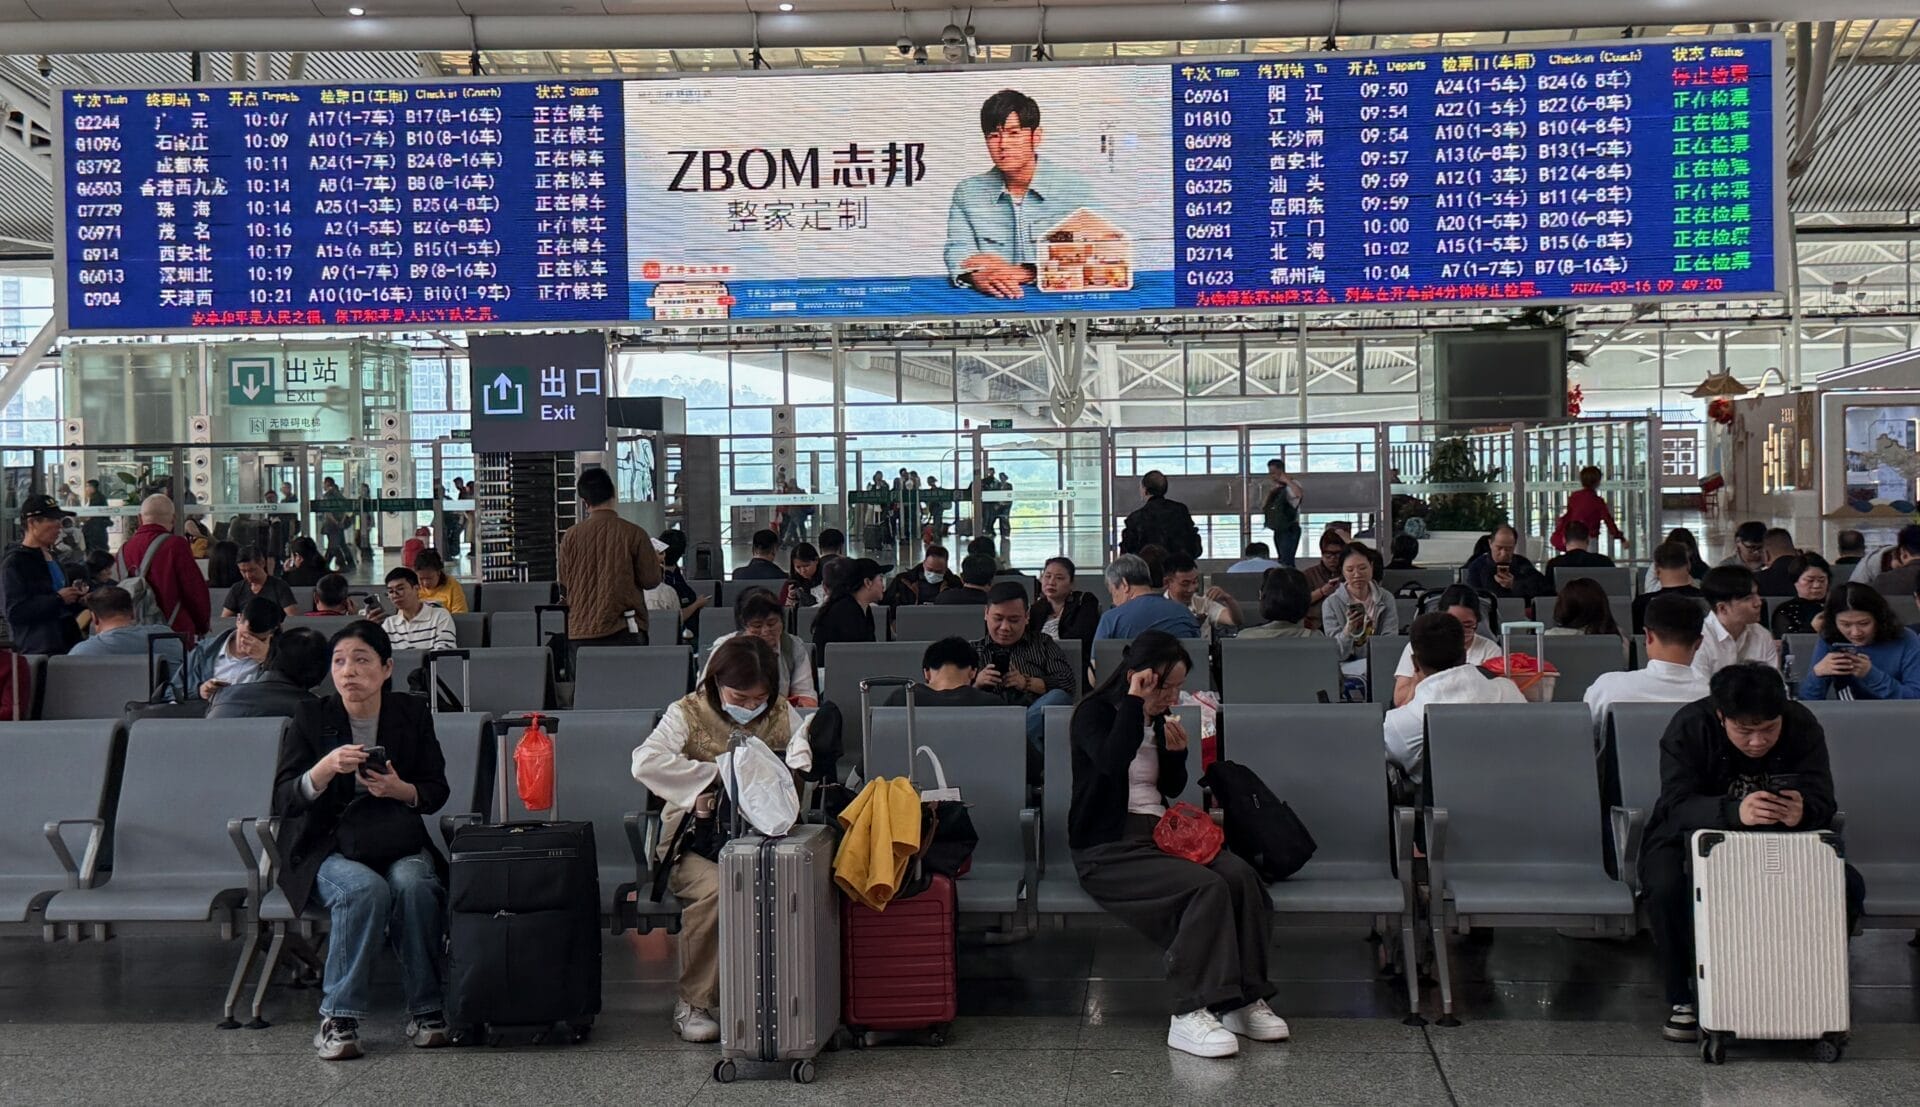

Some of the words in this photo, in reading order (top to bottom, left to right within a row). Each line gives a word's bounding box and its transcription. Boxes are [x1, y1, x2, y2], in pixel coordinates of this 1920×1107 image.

[1181, 67, 1211, 82] 车次
[1215, 67, 1239, 78] Train
[1348, 60, 1380, 76] 开点
[1672, 46, 1704, 63] 状态
[228, 92, 259, 107] 开点
[535, 85, 565, 100] 状态
[570, 86, 599, 97] Status
[1360, 82, 1409, 99] 09:50
[1434, 75, 1527, 95] A24(1-5车)
[1537, 70, 1632, 91] B24(68车)
[1672, 65, 1749, 87] 停止检票
[75, 115, 121, 130] G2244
[244, 112, 289, 127] 10:07
[308, 110, 395, 127] A17(1-7车)
[406, 107, 502, 125] B17(8-16车)
[533, 104, 605, 123] 正在候车
[1184, 111, 1232, 127] D1810
[1360, 105, 1408, 122] 09:54
[1434, 98, 1527, 118] A22(1-5车)
[1538, 94, 1632, 113] B22(6-8车)
[1672, 88, 1751, 110] 正在检票
[75, 137, 121, 152] G1096
[155, 133, 209, 151] 石家庄
[244, 133, 289, 149] 10:09
[308, 131, 395, 149] A10(1-7车)
[407, 128, 502, 146] B10(8-16车)
[534, 126, 605, 146] 正在候车
[1185, 133, 1232, 150] G6098
[1361, 127, 1409, 144] 09:54
[1434, 121, 1527, 141] A10(1-3车)
[1538, 116, 1632, 137] B10(4-8车)
[1671, 111, 1751, 133] 正在检票
[76, 159, 122, 174] G3792
[156, 156, 209, 173] 成都东
[244, 157, 288, 172] 10:11
[309, 154, 396, 171] A24(1-7车)
[407, 151, 503, 169] B24(8-16车)
[535, 149, 606, 168] 正在候车
[667, 147, 820, 192] ZBOM
[833, 142, 926, 188] 志邦
[1185, 156, 1232, 172] G2240
[1269, 151, 1325, 171] 西安北
[1361, 151, 1409, 167] 09:57
[1435, 143, 1527, 164] A13(6-8车)
[1538, 139, 1632, 160] B13(1-5车)
[1672, 134, 1751, 156] 正在检票
[77, 181, 122, 196] G6503
[139, 177, 228, 197] 香港西九龙
[246, 179, 290, 194] 10:14
[318, 175, 396, 194] A8(1-7车)
[408, 173, 495, 191] B8(8-16车)
[535, 171, 606, 190] 正在候车
[1186, 180, 1233, 195] G6325
[1361, 173, 1410, 189] 09:59
[1435, 168, 1528, 185] A12(13车)
[1538, 162, 1632, 183] B12(4-8车)
[1672, 158, 1751, 179] 正在检票
[246, 200, 291, 216] 10:14
[315, 197, 402, 215] A25(1-3车)
[413, 195, 500, 213] B25(4-8车)
[536, 194, 606, 212] 正在候车
[1186, 201, 1233, 217] G6142
[1269, 196, 1325, 216] 岳阳东
[1361, 196, 1410, 212] 09:59
[1435, 189, 1528, 209] A11(1-3车)
[1539, 185, 1632, 206] B11(4-8车)
[1673, 181, 1752, 202] 正在检票
[247, 223, 293, 237] 10:16
[325, 219, 402, 237] A2(1-5车)
[413, 218, 491, 236] B2(6-8车)
[537, 215, 607, 235] 正在候车
[727, 196, 868, 232] 整家定制
[1363, 218, 1410, 234] 10:00
[1435, 212, 1528, 232] A20(1-5车)
[1539, 208, 1633, 229] B20(6-8车)
[1672, 204, 1752, 225] 正在检票
[159, 244, 213, 262] 西安北
[247, 245, 292, 260] 10:17
[316, 241, 403, 260] A15(68车)
[413, 239, 501, 257] B15(1-5车)
[536, 238, 606, 257] 正在候车
[1187, 247, 1234, 262] D3714
[1362, 242, 1410, 257] 10:02
[1436, 235, 1529, 255] A15(1-5车)
[1539, 231, 1633, 252] B15(6-8车)
[1673, 227, 1751, 248] 正在检票
[79, 269, 125, 284] G6013
[159, 267, 214, 285] 深圳北
[248, 266, 293, 282] 10:19
[322, 264, 399, 281] A9(1-7车)
[410, 261, 497, 279] B9(8-16车)
[537, 259, 609, 278] 正在候车
[1270, 266, 1326, 286] 福州南
[1362, 265, 1411, 281] 10:04
[1440, 259, 1524, 278] A7(1-7车)
[1535, 256, 1628, 276] B7(8-16车)
[1673, 251, 1753, 272] 正在检票
[160, 289, 214, 307] 天津西
[249, 289, 291, 303] 10:21
[308, 287, 413, 304] A10(10-16车)
[423, 284, 511, 302] B10(1-9车)
[538, 282, 609, 301] 正在候车
[286, 357, 339, 385] 出站
[541, 366, 601, 398] 出口
[287, 390, 317, 403] Exit
[270, 417, 321, 429] 无障碍电梯
[541, 405, 577, 421] Exit
